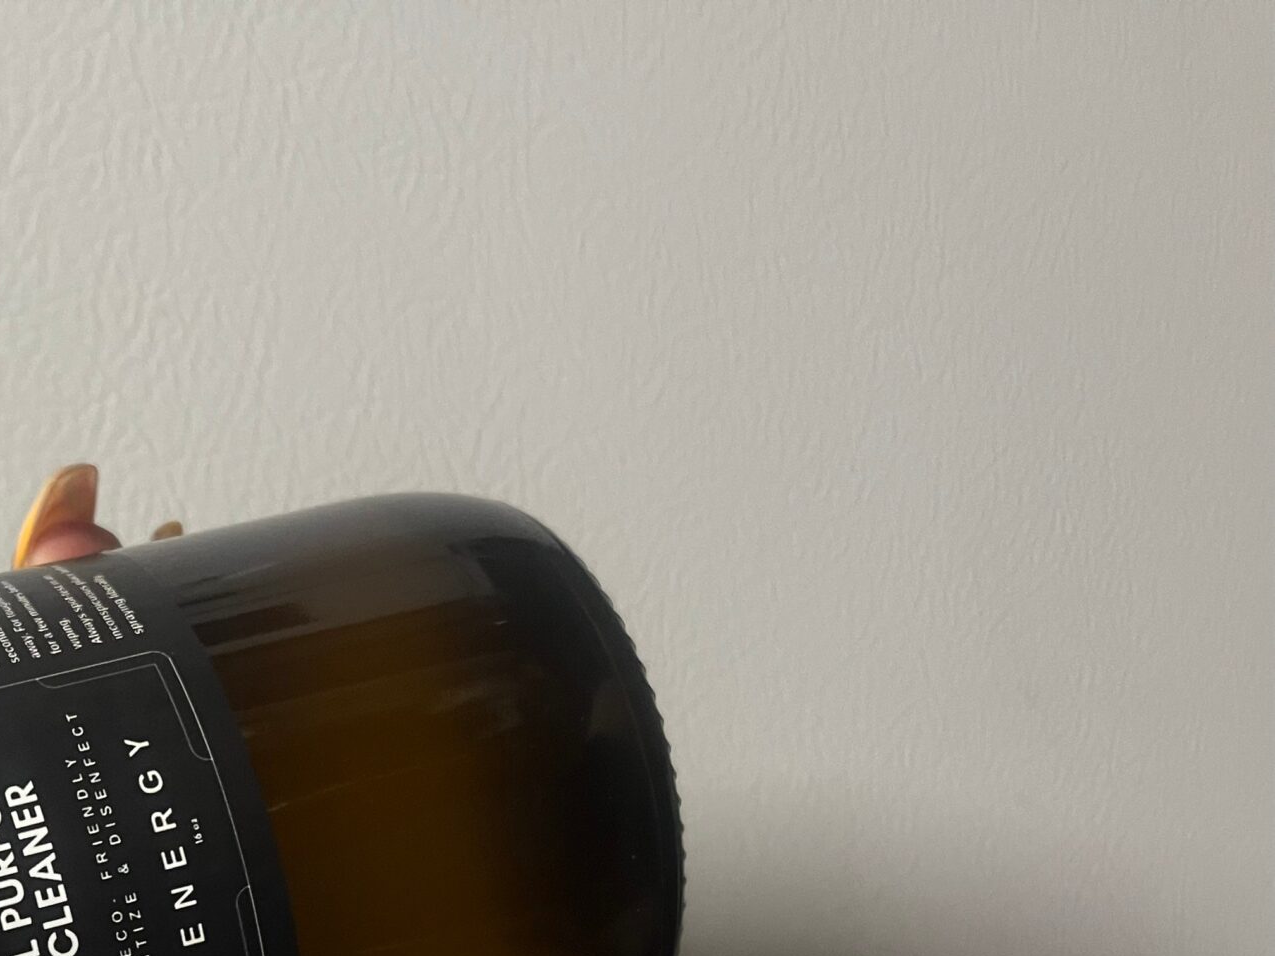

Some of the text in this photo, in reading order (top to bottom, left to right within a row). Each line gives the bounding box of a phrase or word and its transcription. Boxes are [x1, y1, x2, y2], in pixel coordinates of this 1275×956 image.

[15, 592, 39, 617] minutes
[79, 585, 124, 640] inconspicuous
[114, 598, 144, 635] spraying
[10, 618, 26, 633] For
[33, 617, 49, 632] few
[58, 617, 83, 650] wiping.
[77, 612, 104, 644] Always
[21, 632, 42, 659] away.
[47, 640, 62, 655] for
[65, 714, 121, 845] DISENFECT
[64, 759, 112, 879] FRIENDLY
[123, 739, 205, 946] ENERGY
[193, 832, 203, 844] 16
[117, 863, 129, 873] &
